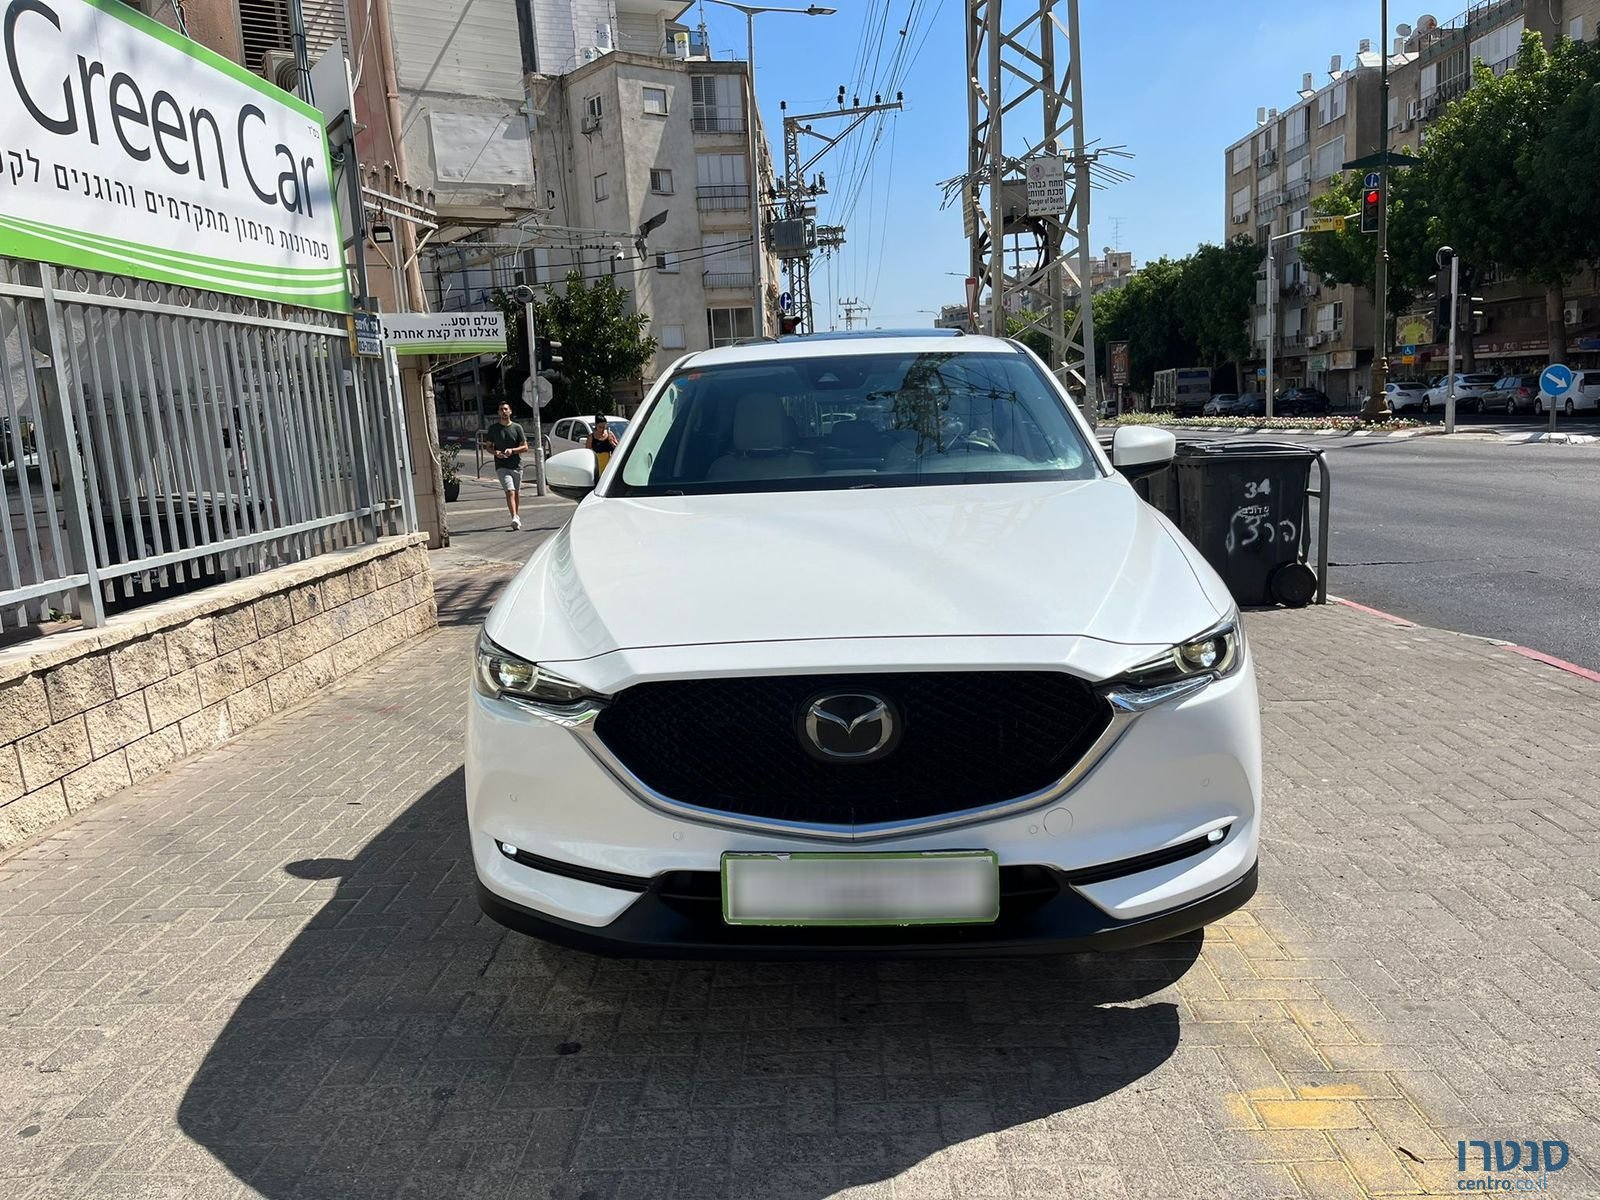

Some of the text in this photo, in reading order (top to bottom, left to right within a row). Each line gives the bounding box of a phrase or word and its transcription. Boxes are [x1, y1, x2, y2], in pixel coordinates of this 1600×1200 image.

[4, 0, 314, 219] Green Car
[1049, 179, 1063, 188] מתח
[1047, 188, 1064, 196] סכנת
[0, 148, 329, 261] פתרונות מימון מתקדמים והוגנים לק
[441, 315, 498, 327] שלם וסע...
[393, 329, 424, 339] אחרת
[427, 329, 451, 340] קצת
[454, 329, 466, 338] זה
[469, 326, 499, 338] אצלנו
[1244, 478, 1271, 498] 34
